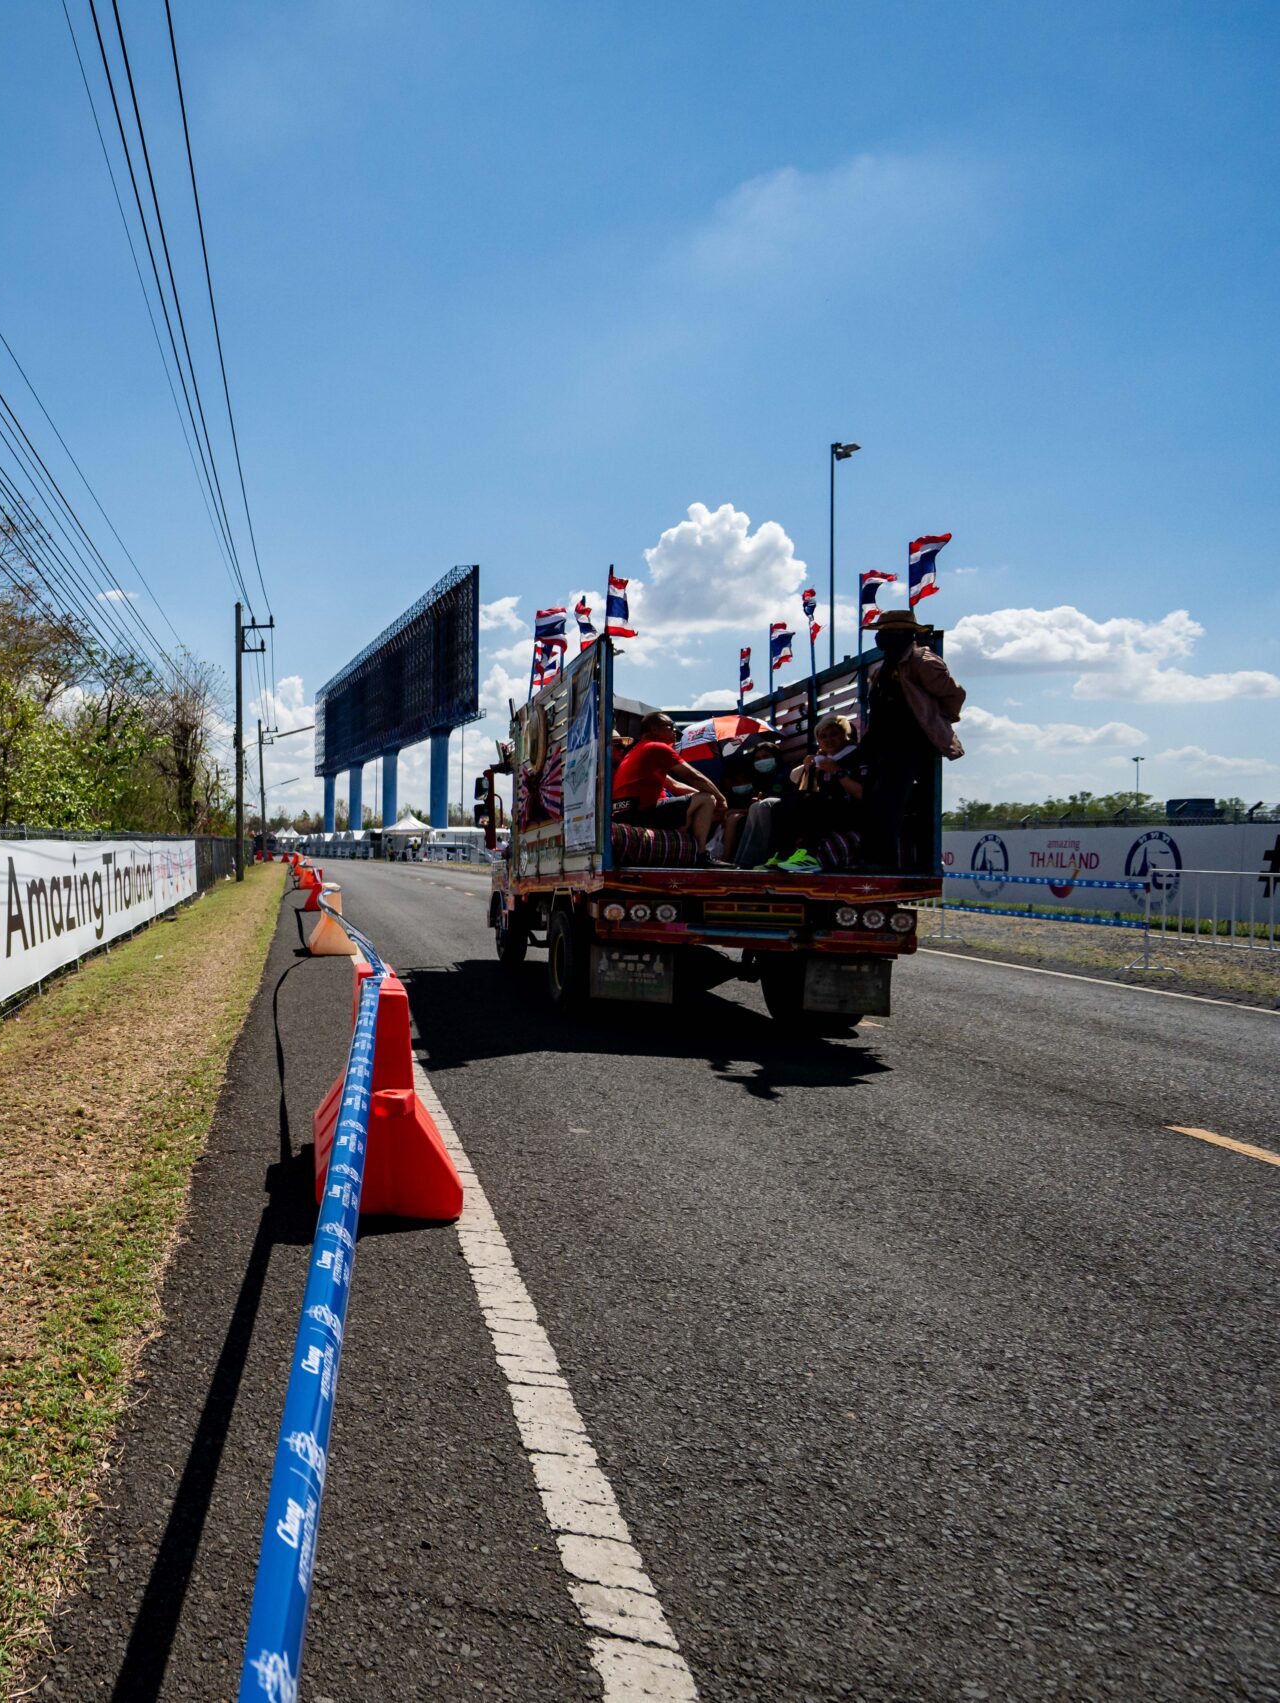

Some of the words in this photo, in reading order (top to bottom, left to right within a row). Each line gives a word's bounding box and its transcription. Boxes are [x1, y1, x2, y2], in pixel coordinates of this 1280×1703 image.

[1047, 838, 1080, 851] amazing
[1029, 852, 1099, 869] THAILAND
[300, 1344, 324, 1375] Chang
[276, 1497, 305, 1549] Chang
